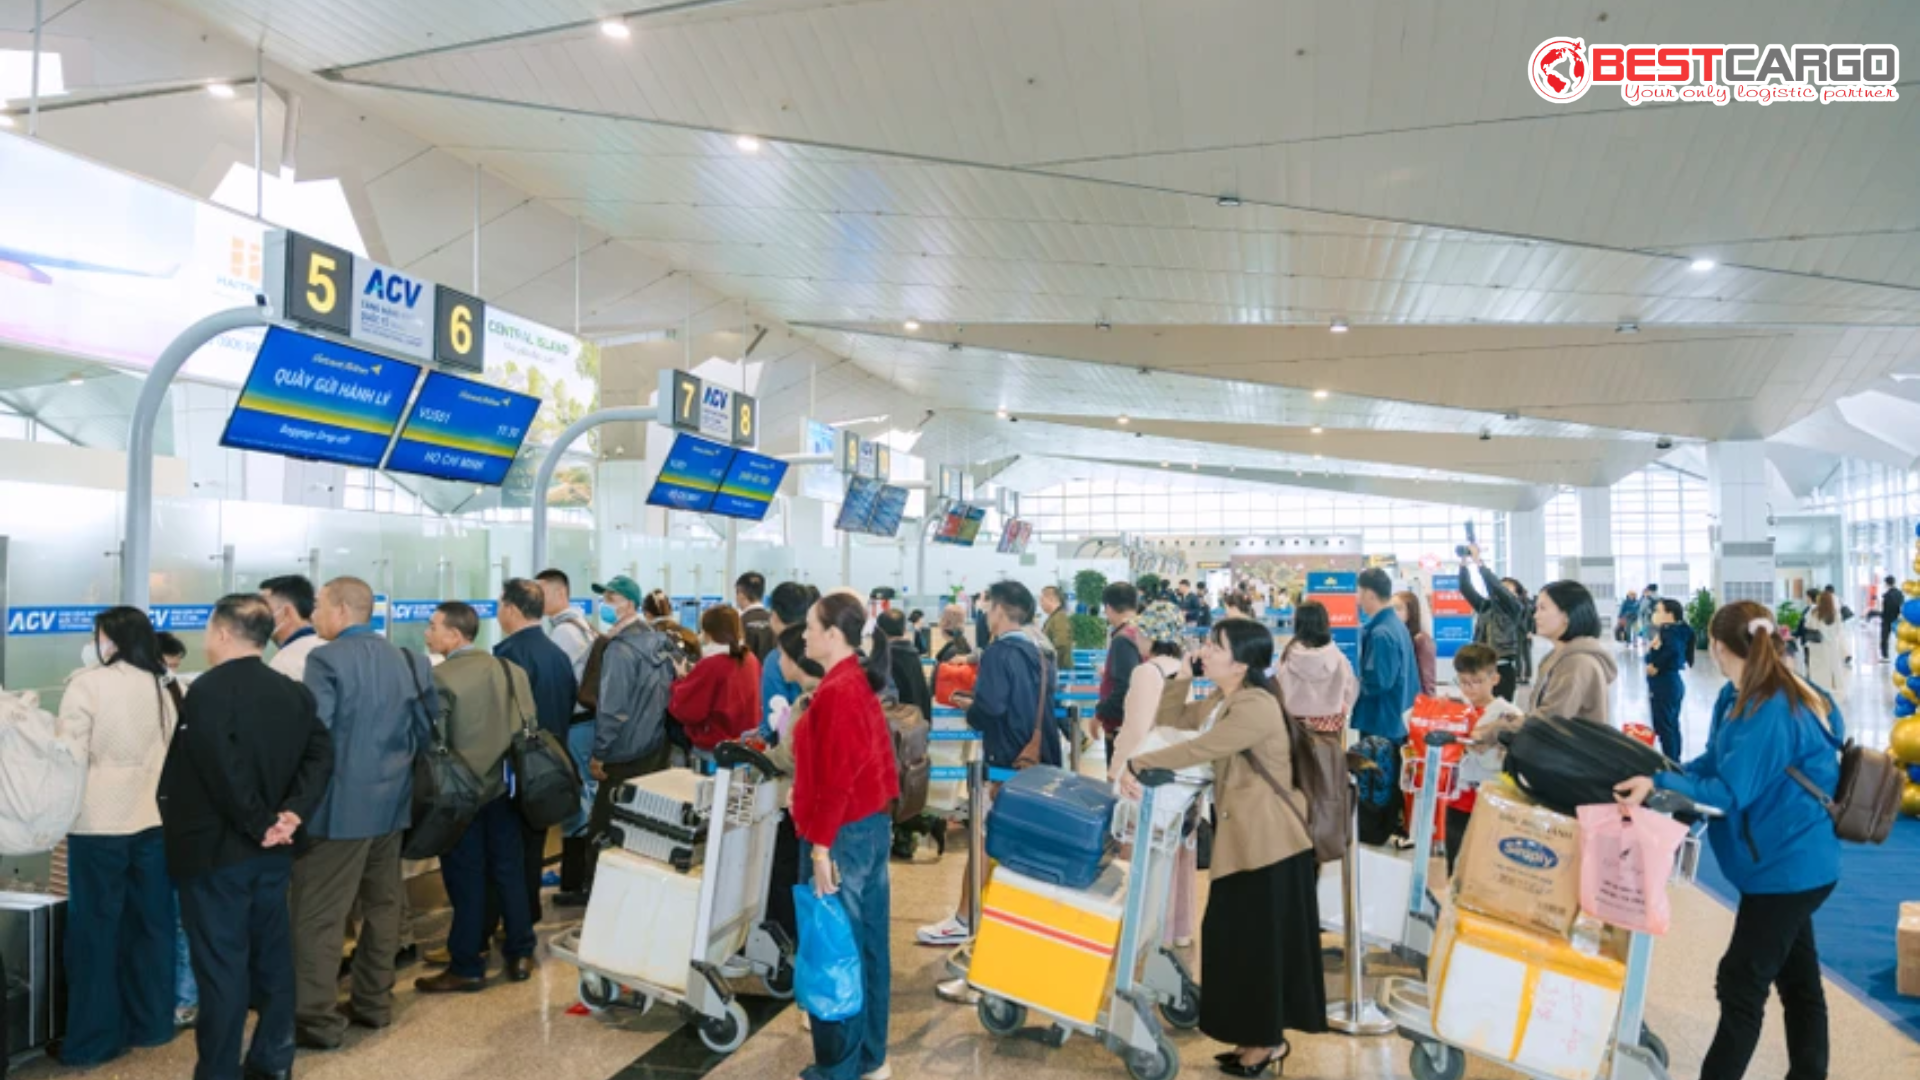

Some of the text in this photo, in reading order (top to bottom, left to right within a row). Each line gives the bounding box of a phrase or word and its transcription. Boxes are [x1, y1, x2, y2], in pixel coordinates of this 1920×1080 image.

[306, 252, 337, 314] 5
[364, 267, 423, 309] ACV
[450, 304, 473, 354] 6
[682, 382, 696, 418] 7
[703, 387, 729, 410] ACV
[740, 404, 751, 436] 8
[9, 611, 57, 632] ACV
